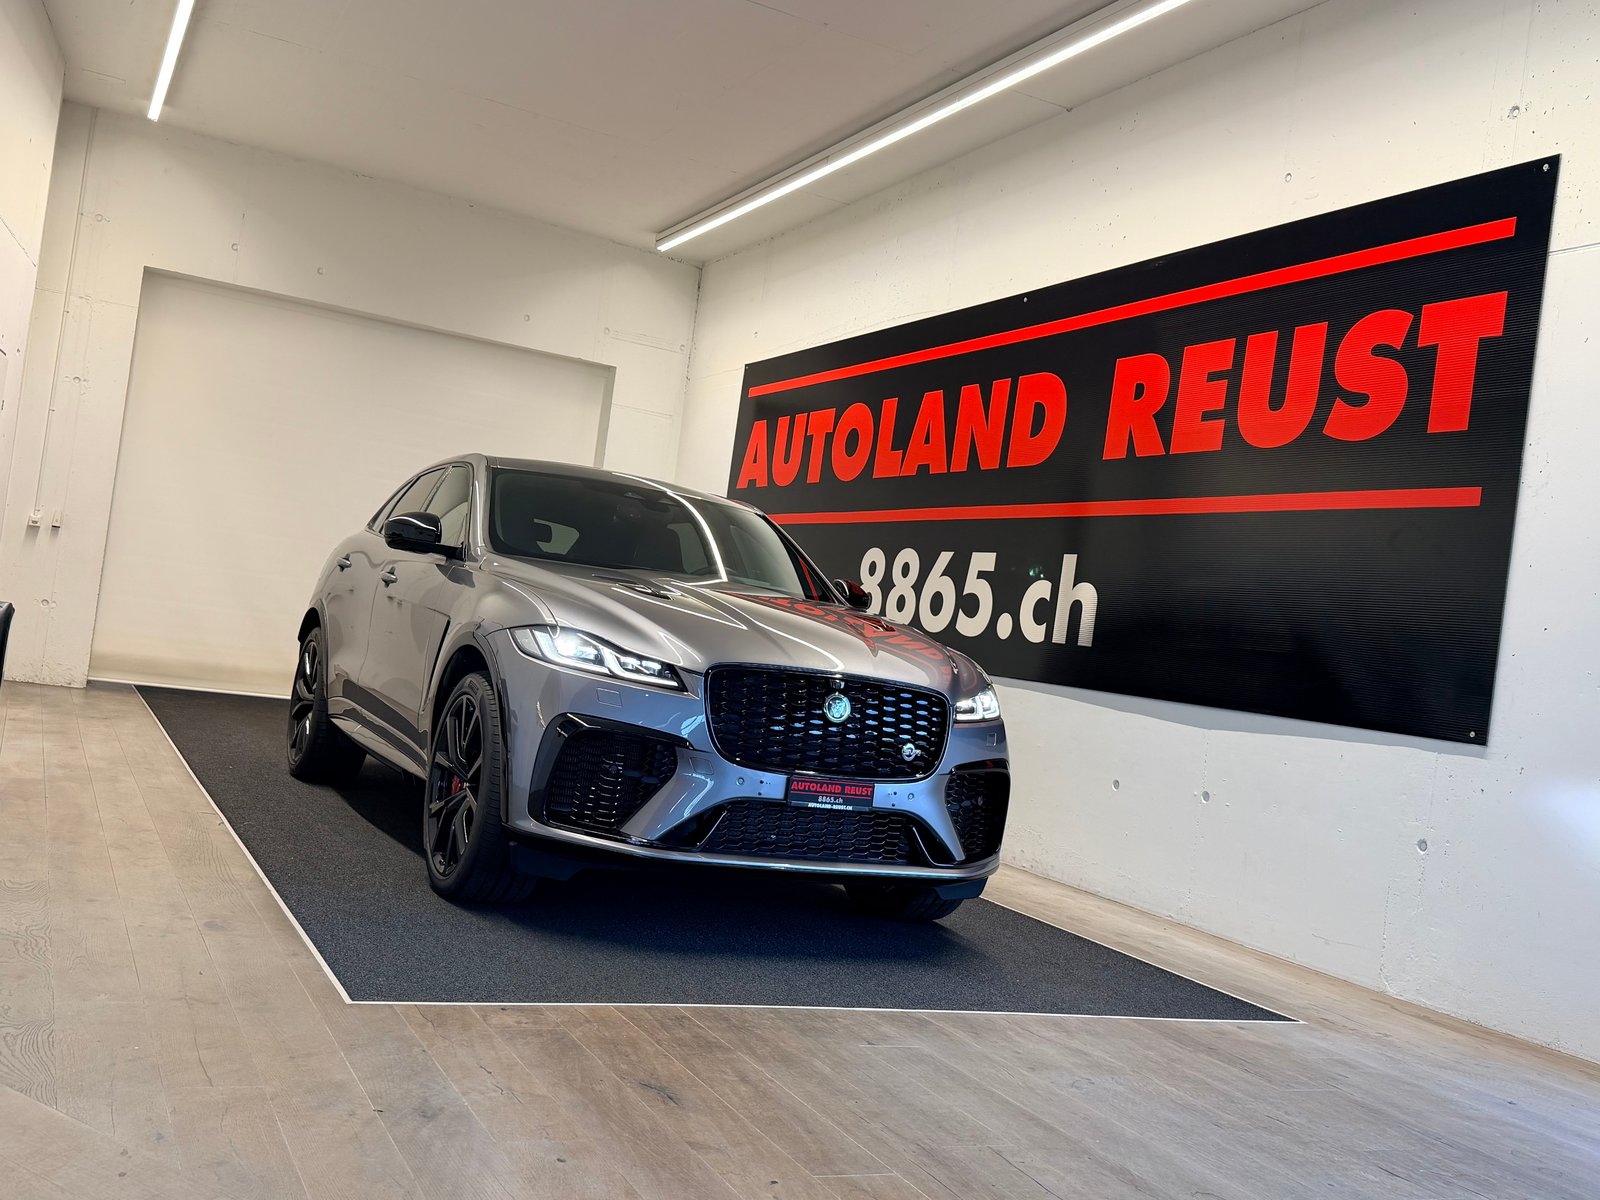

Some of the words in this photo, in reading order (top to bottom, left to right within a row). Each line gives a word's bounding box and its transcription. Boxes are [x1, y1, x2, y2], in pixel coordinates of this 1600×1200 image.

[737, 372, 1068, 489] AUTOLAND
[1103, 291, 1509, 460] REUST
[860, 547, 1098, 647] 8865.ch
[791, 782, 842, 793] AUTOLAND
[845, 786, 873, 796] REUST
[817, 796, 844, 804] 8865.ch
